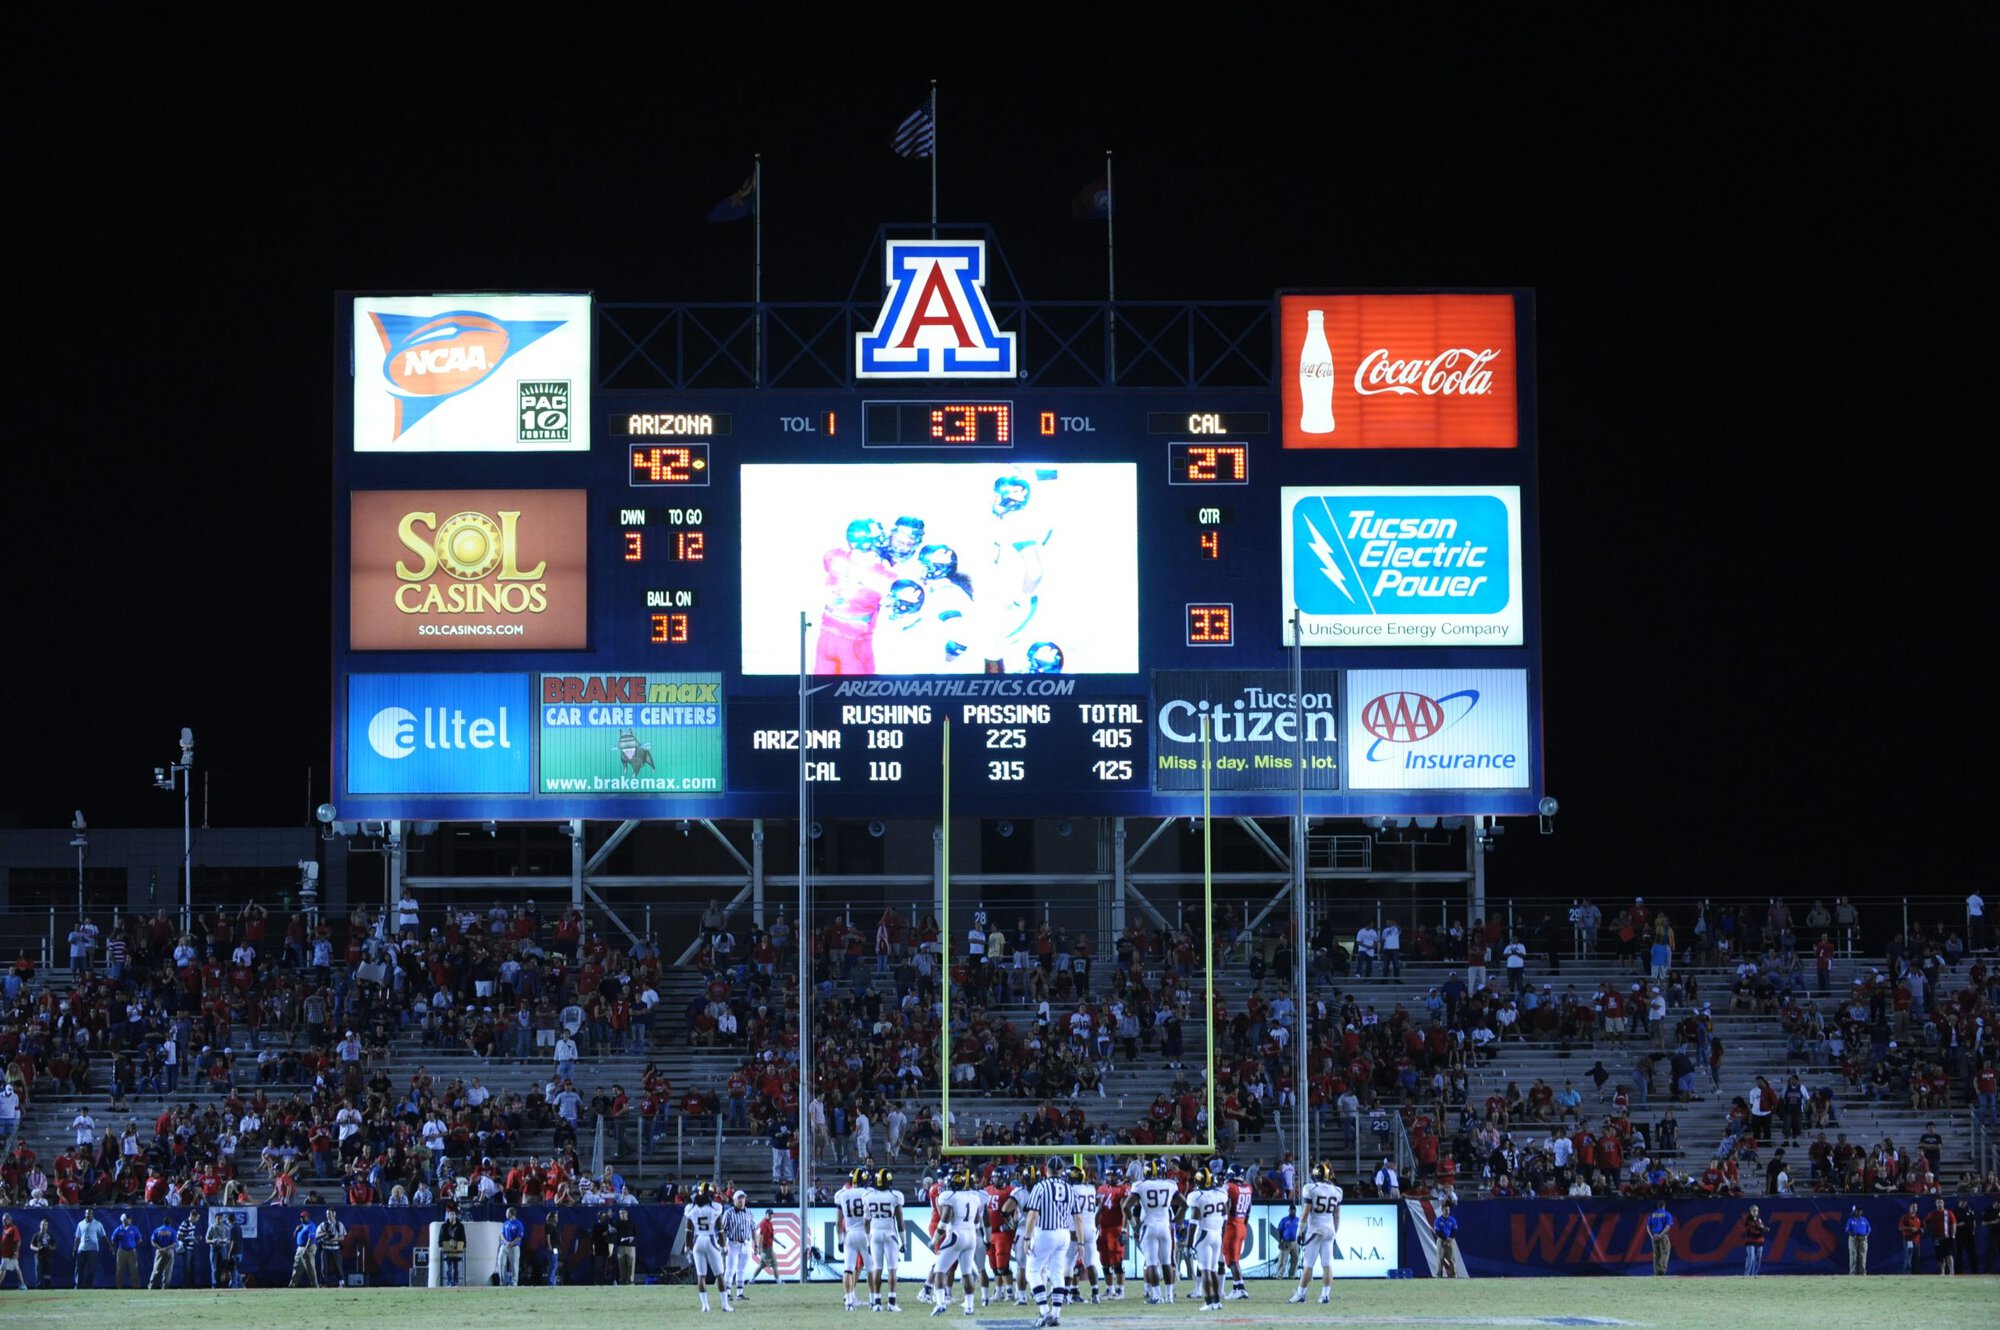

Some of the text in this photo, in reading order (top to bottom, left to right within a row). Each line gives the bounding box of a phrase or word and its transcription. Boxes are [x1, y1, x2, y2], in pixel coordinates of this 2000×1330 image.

[1354, 348, 1501, 396] Coca-Cola
[521, 396, 567, 410] PAC
[521, 410, 567, 430] 10
[629, 414, 713, 435] ARIZONA
[780, 417, 815, 432] TOL
[829, 412, 835, 435] 1
[1041, 412, 1055, 435] 0
[1060, 417, 1096, 432] TOL
[1189, 414, 1226, 434] CAL
[521, 430, 567, 439] FOOTBALL
[634, 449, 689, 480] 42
[1188, 447, 1244, 479] 27
[620, 510, 645, 525] DWN
[669, 509, 702, 525] TO GO
[1199, 508, 1220, 524] QTR
[1346, 510, 1457, 540] Tucson
[395, 511, 546, 582] SOL
[625, 532, 642, 561] 3
[678, 532, 704, 561] 12
[1202, 532, 1218, 558] 4
[1359, 540, 1488, 568] Electric
[1372, 569, 1487, 598] Power
[395, 583, 547, 613] CASINOS
[647, 591, 692, 606] BALL ON
[418, 624, 524, 636] SOLCASINOS.COM
[651, 614, 687, 642] 33
[1191, 609, 1229, 641] 33
[1309, 622, 1383, 636] UniSource
[1387, 622, 1437, 638] Energy
[1441, 622, 1509, 638] Company
[834, 679, 1076, 698] ARIZONAATHLETICS.COM
[1244, 687, 1333, 709] Tucson
[546, 706, 717, 726] CAR CARE CENTERS
[842, 704, 1143, 724] RUSHING PASSING TOTAL
[1158, 699, 1337, 743] Citizen
[1370, 692, 1438, 742] AAA
[368, 706, 511, 759] alltel
[867, 730, 903, 749] 180
[986, 729, 1026, 749] 225
[1092, 729, 1132, 748] 405
[1159, 756, 1197, 769] Miss
[1216, 755, 1249, 772] day.
[1254, 755, 1293, 768] Miss
[1311, 755, 1337, 769] lot.
[1405, 750, 1516, 770] Insurance
[804, 762, 841, 781] CAL
[869, 761, 901, 781] 110
[988, 761, 1024, 781] 315
[546, 775, 717, 790] www.brakemax.com
[974, 911, 987, 925] 28
[1372, 1120, 1389, 1131] 29
[666, 1184, 673, 1197] 7
[1146, 1189, 1170, 1209] 97
[845, 1198, 865, 1218] 18
[868, 1202, 892, 1219] 25
[963, 1203, 970, 1222] 1
[1313, 1195, 1338, 1214] 56
[697, 1216, 710, 1231] 5
[1364, 1216, 1384, 1227] TM
